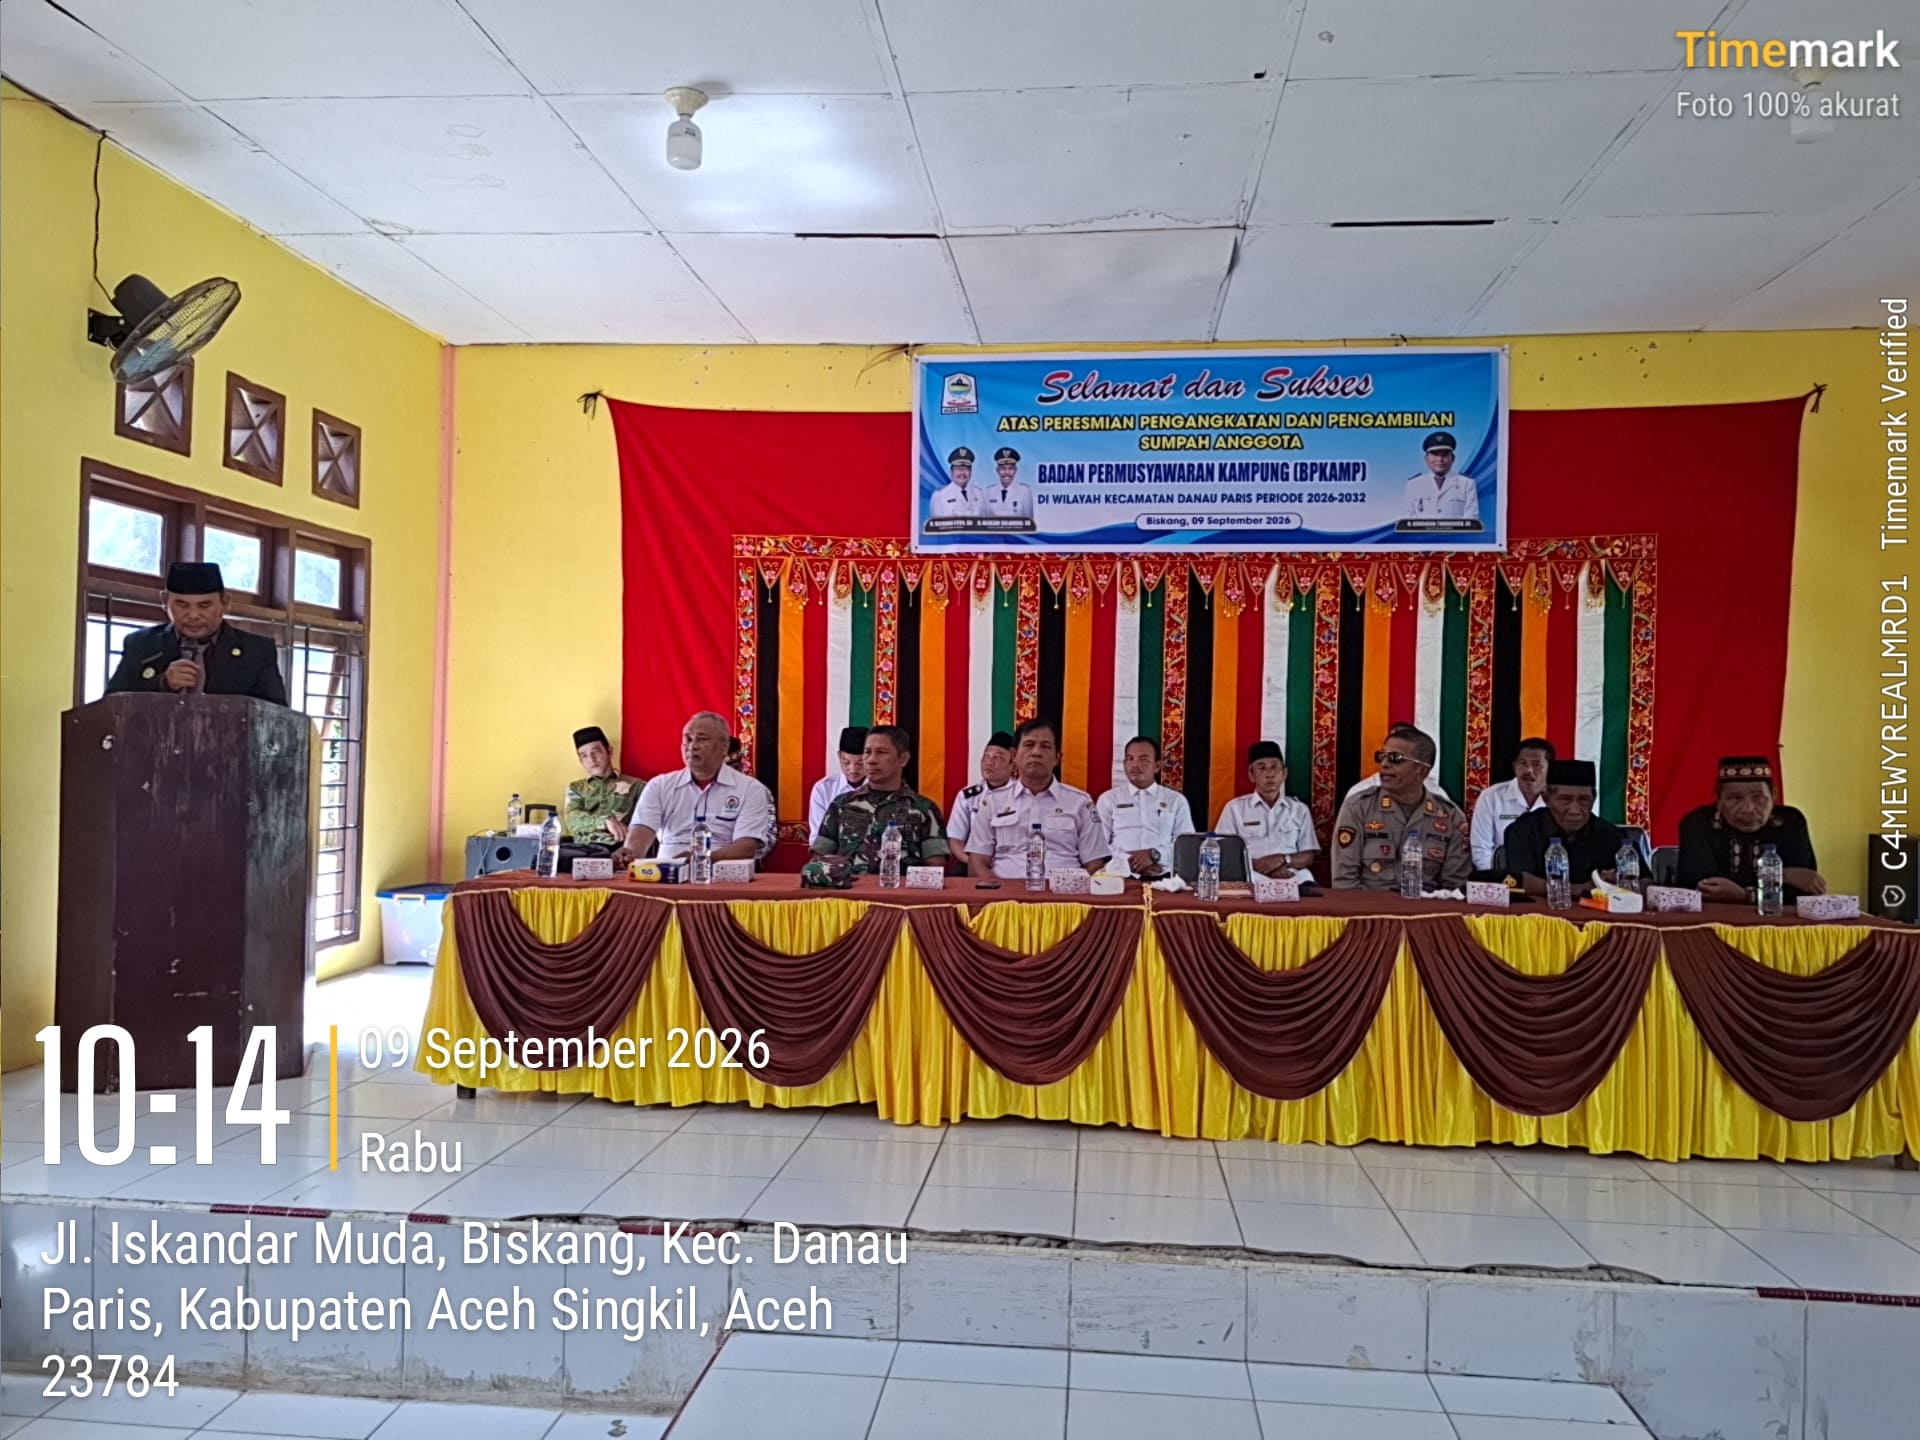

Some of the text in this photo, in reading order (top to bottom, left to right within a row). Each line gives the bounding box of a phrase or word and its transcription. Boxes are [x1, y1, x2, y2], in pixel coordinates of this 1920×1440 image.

[1036, 365, 1373, 404] Selamat dan Sukses
[998, 411, 1455, 431] ATAS PERESMIAN PENGANGKATAN DAN PENGAMBILAN
[1140, 434, 1304, 450] SUMPAH ANGGOTA
[1038, 461, 1367, 484] BADAN PERMUSYAWARAN KAMPUNG (BPKAMP)
[1037, 492, 1367, 504] DI WILAYAH KECAMATAN DANAU PARIS PERIODE 2026-2032
[1146, 516, 1291, 527] Biskang, 09 September 2026
